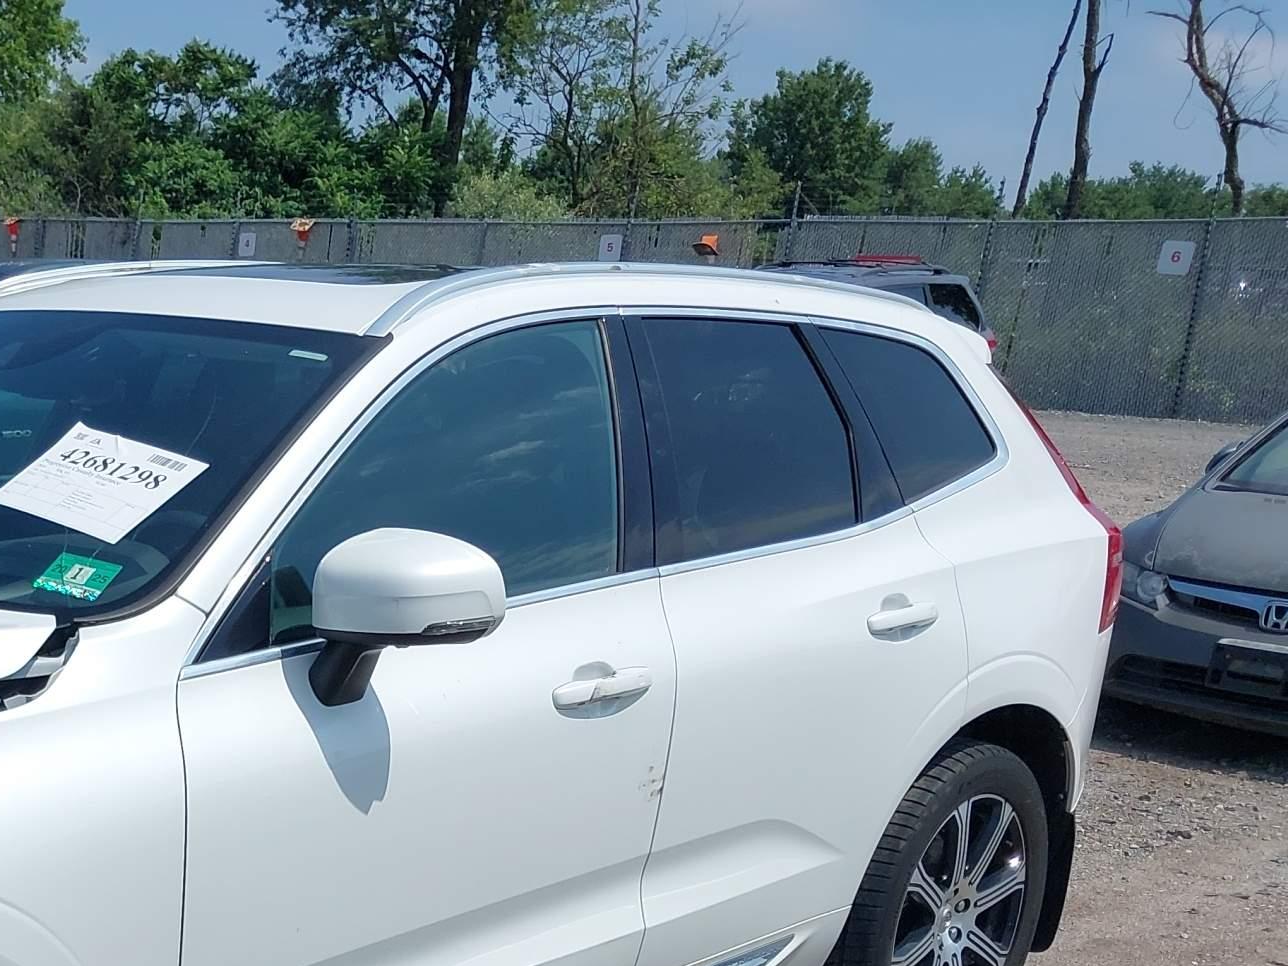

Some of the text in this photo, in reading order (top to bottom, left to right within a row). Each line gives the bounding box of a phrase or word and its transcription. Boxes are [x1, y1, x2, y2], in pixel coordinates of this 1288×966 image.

[607, 242, 614, 253] 5
[1171, 250, 1181, 263] 6
[60, 447, 168, 490] 42681298
[91, 573, 111, 585] 25
